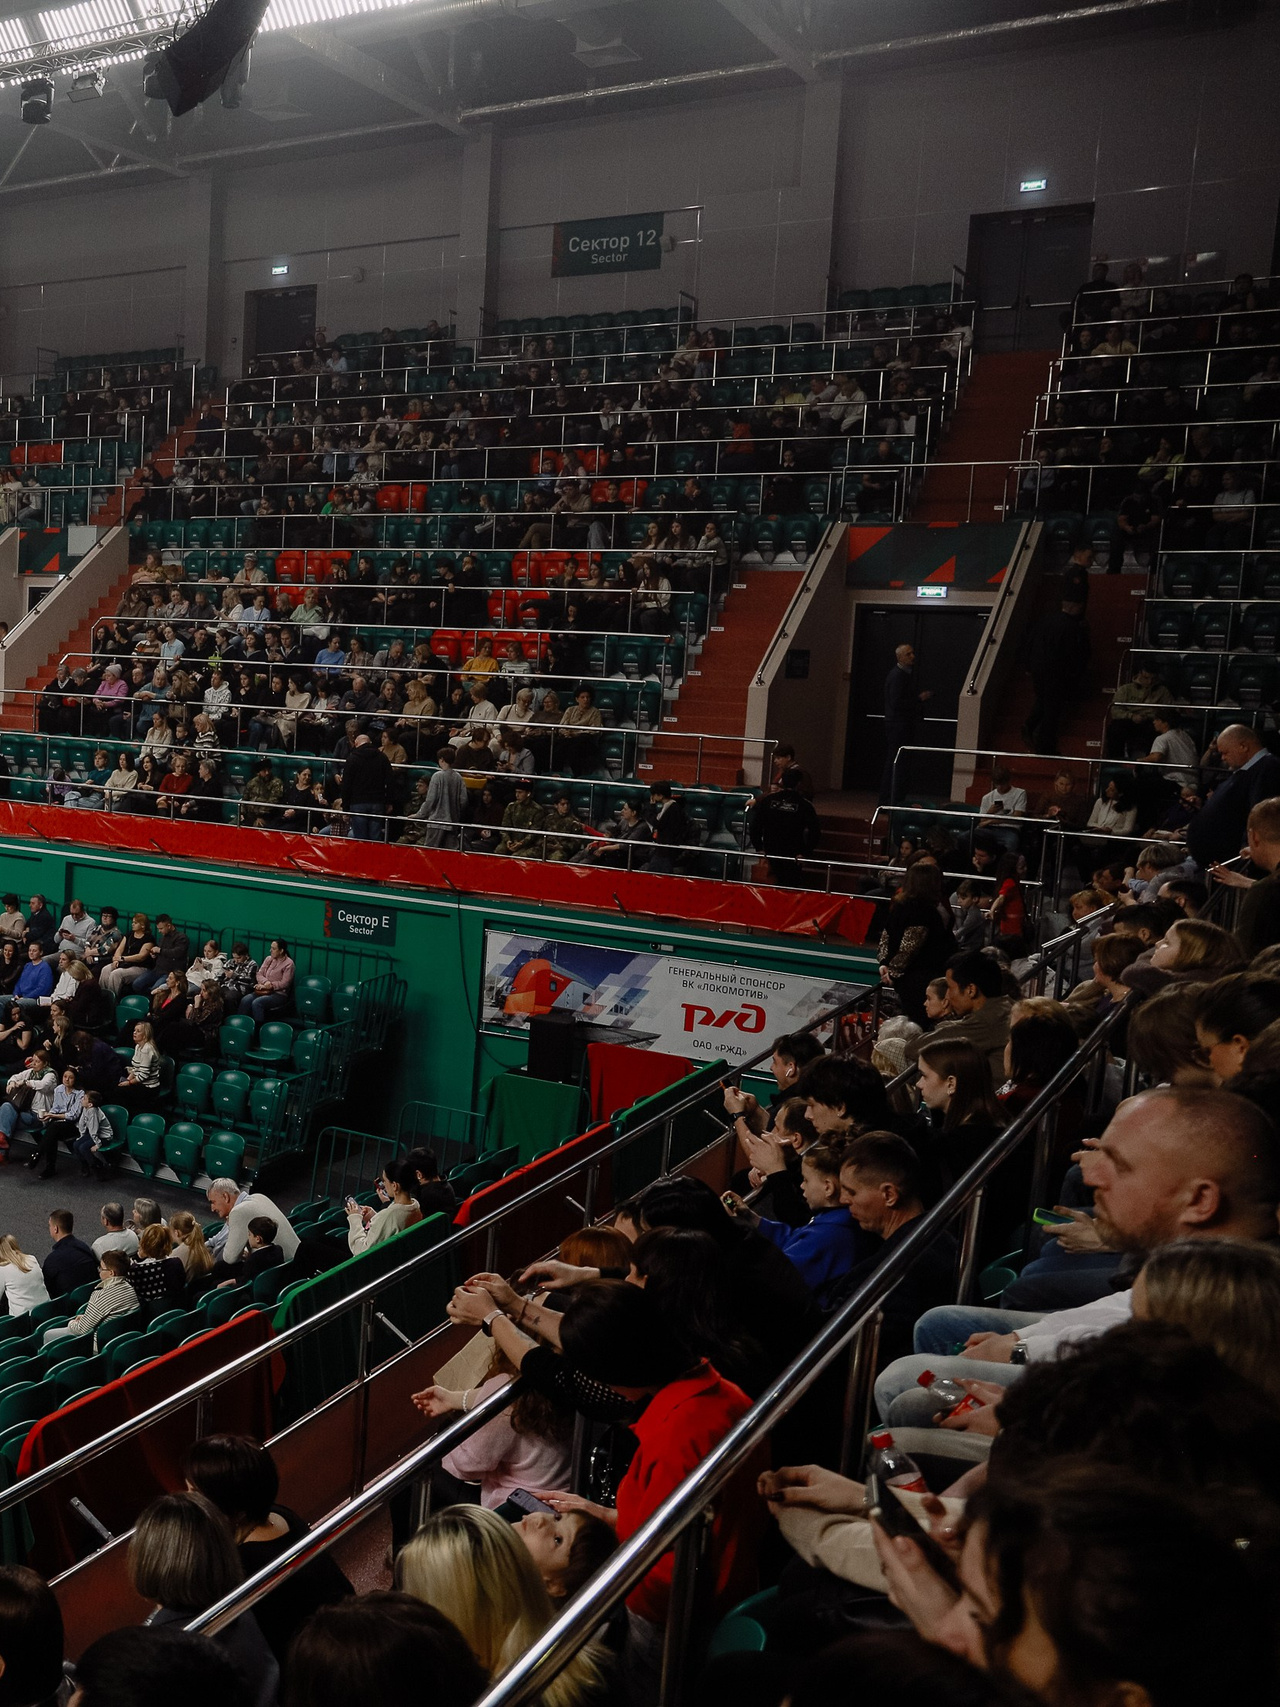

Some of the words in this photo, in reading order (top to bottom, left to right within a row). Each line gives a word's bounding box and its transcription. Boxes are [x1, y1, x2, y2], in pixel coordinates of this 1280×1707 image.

[568, 236, 630, 253] Сектор
[636, 229, 657, 247] 12
[591, 253, 629, 264] Sector
[337, 909, 379, 928] Сектор
[349, 925, 374, 935] Sector
[668, 966, 737, 984] ГЕНЕРАЛЬНЫЙ
[739, 977, 786, 991] СПОНСОР
[682, 980, 694, 990] ВК
[697, 983, 769, 1000] «ЛОКОМОТИВ»
[692, 1039, 712, 1050] ОАО
[714, 1042, 748, 1057] «РЖД»
